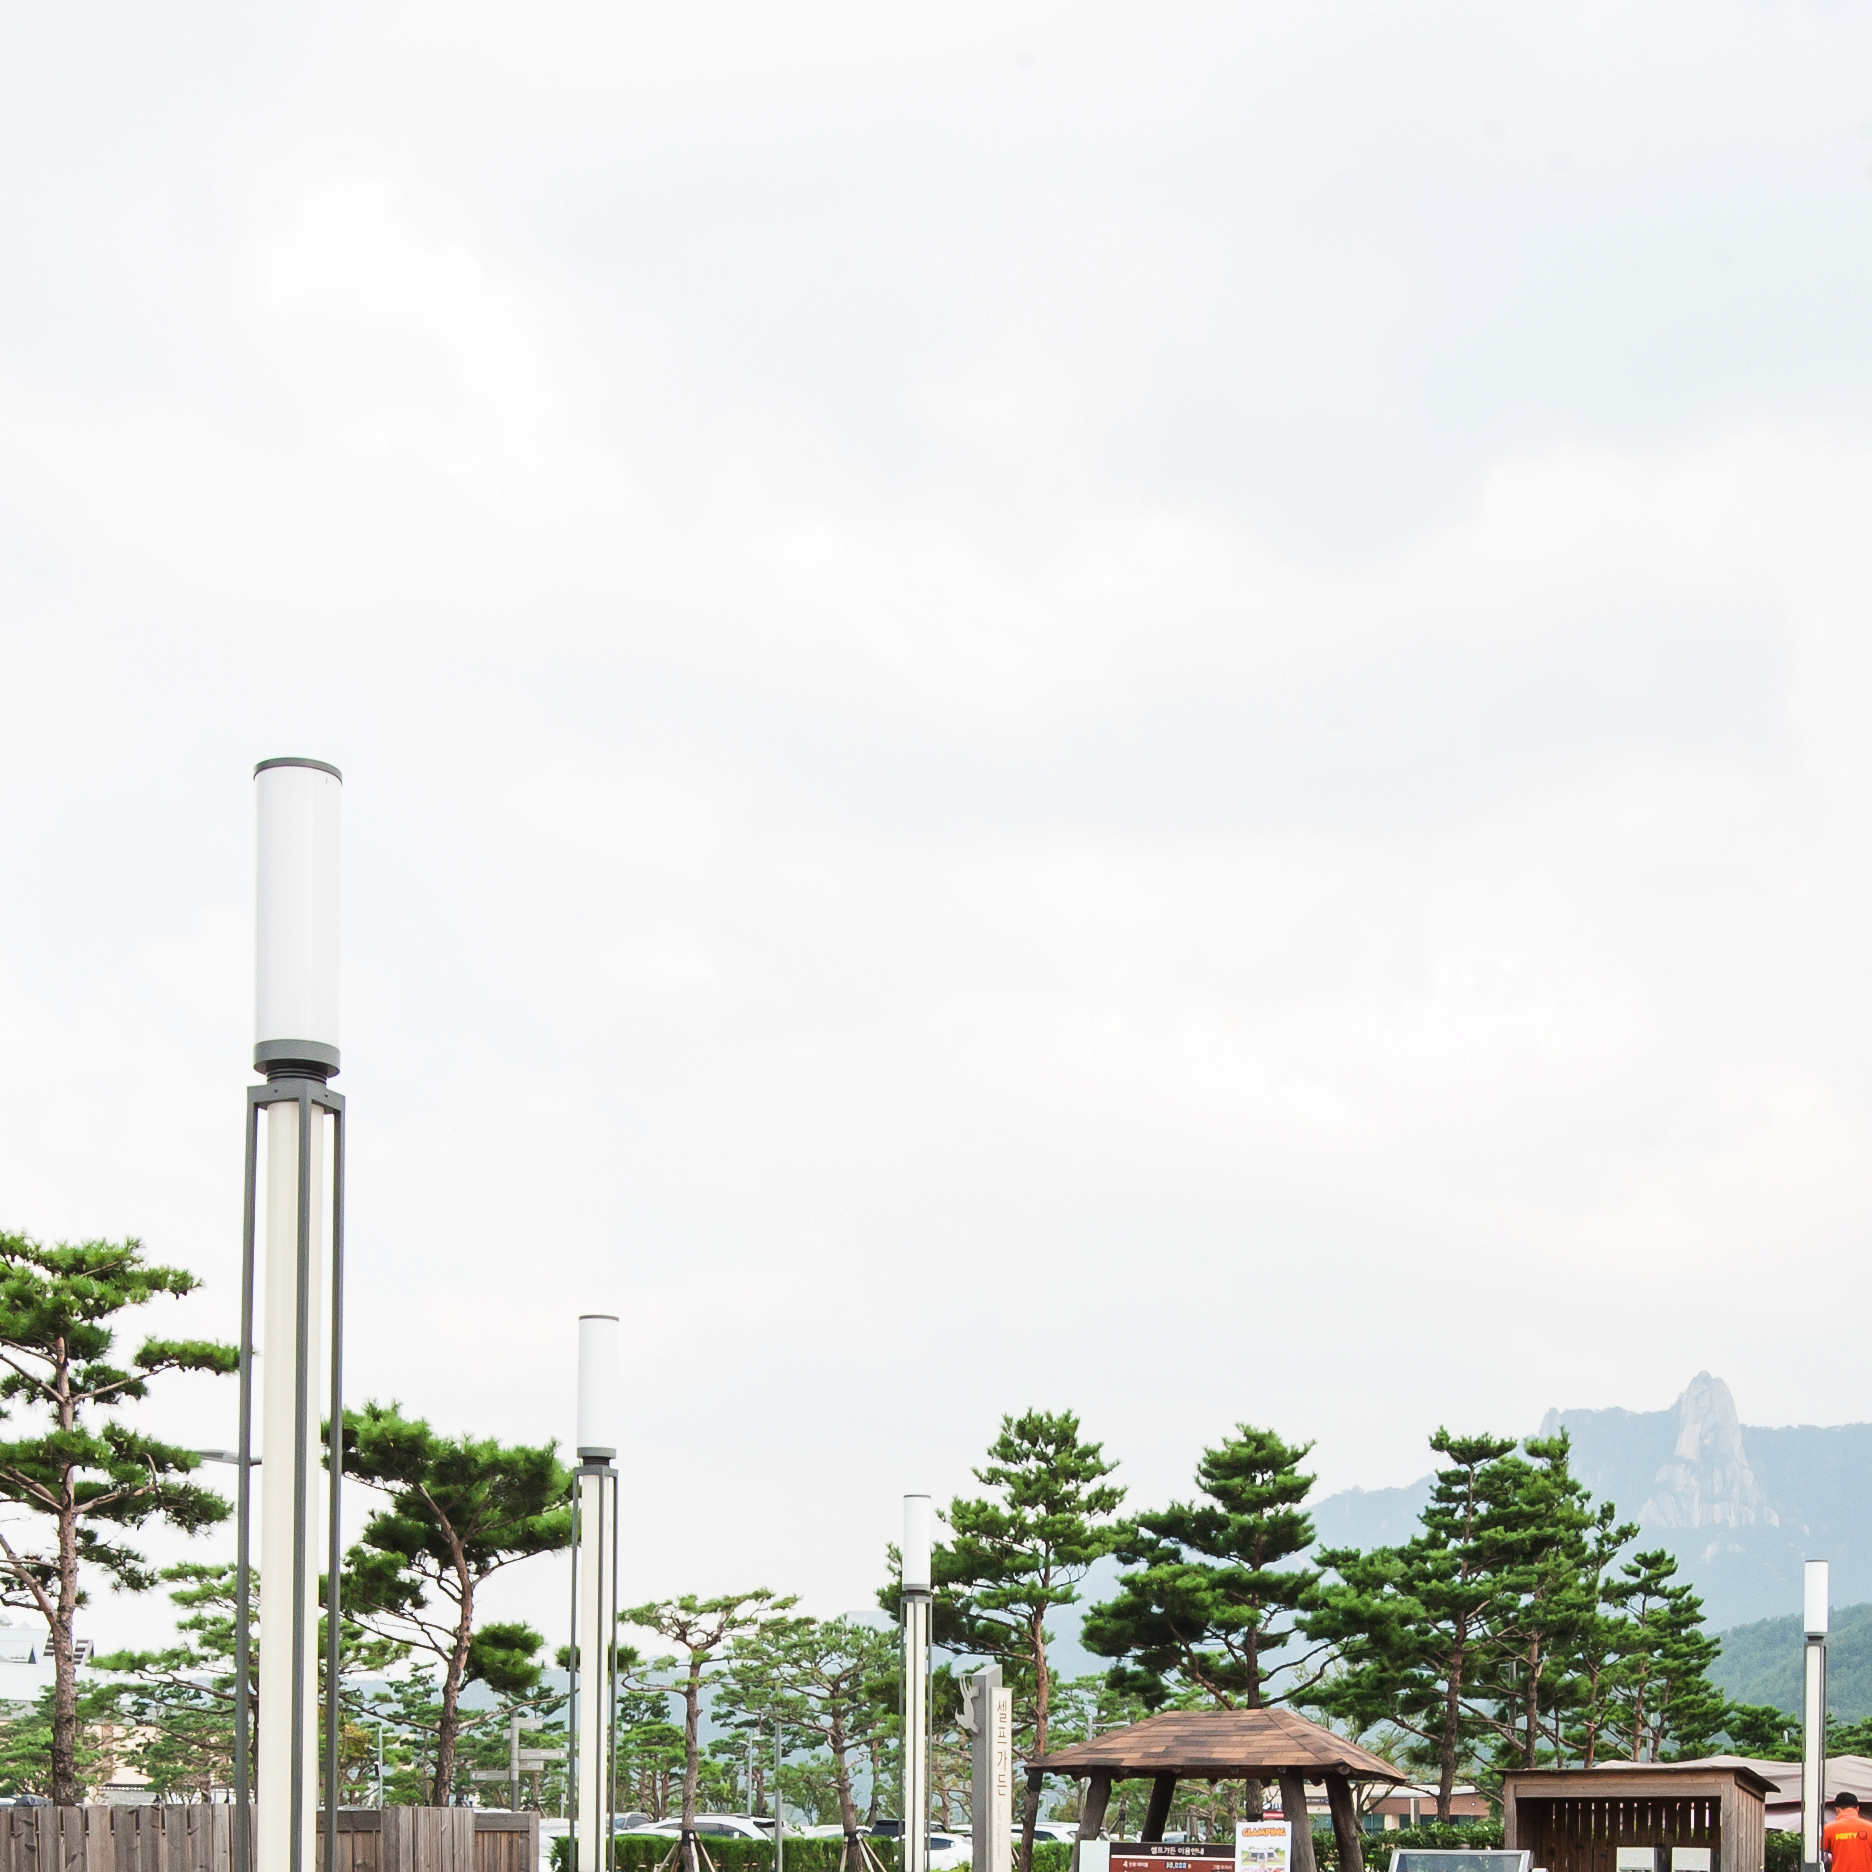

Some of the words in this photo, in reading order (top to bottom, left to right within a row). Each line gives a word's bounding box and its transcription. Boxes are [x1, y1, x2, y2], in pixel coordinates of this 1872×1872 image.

[996, 1700, 1008, 1796] 셀프가든
[1242, 1827, 1286, 1837] GLAMPING
[1150, 1846, 1176, 1855] 셀프가든
[1177, 1846, 1205, 1856] 이용안내
